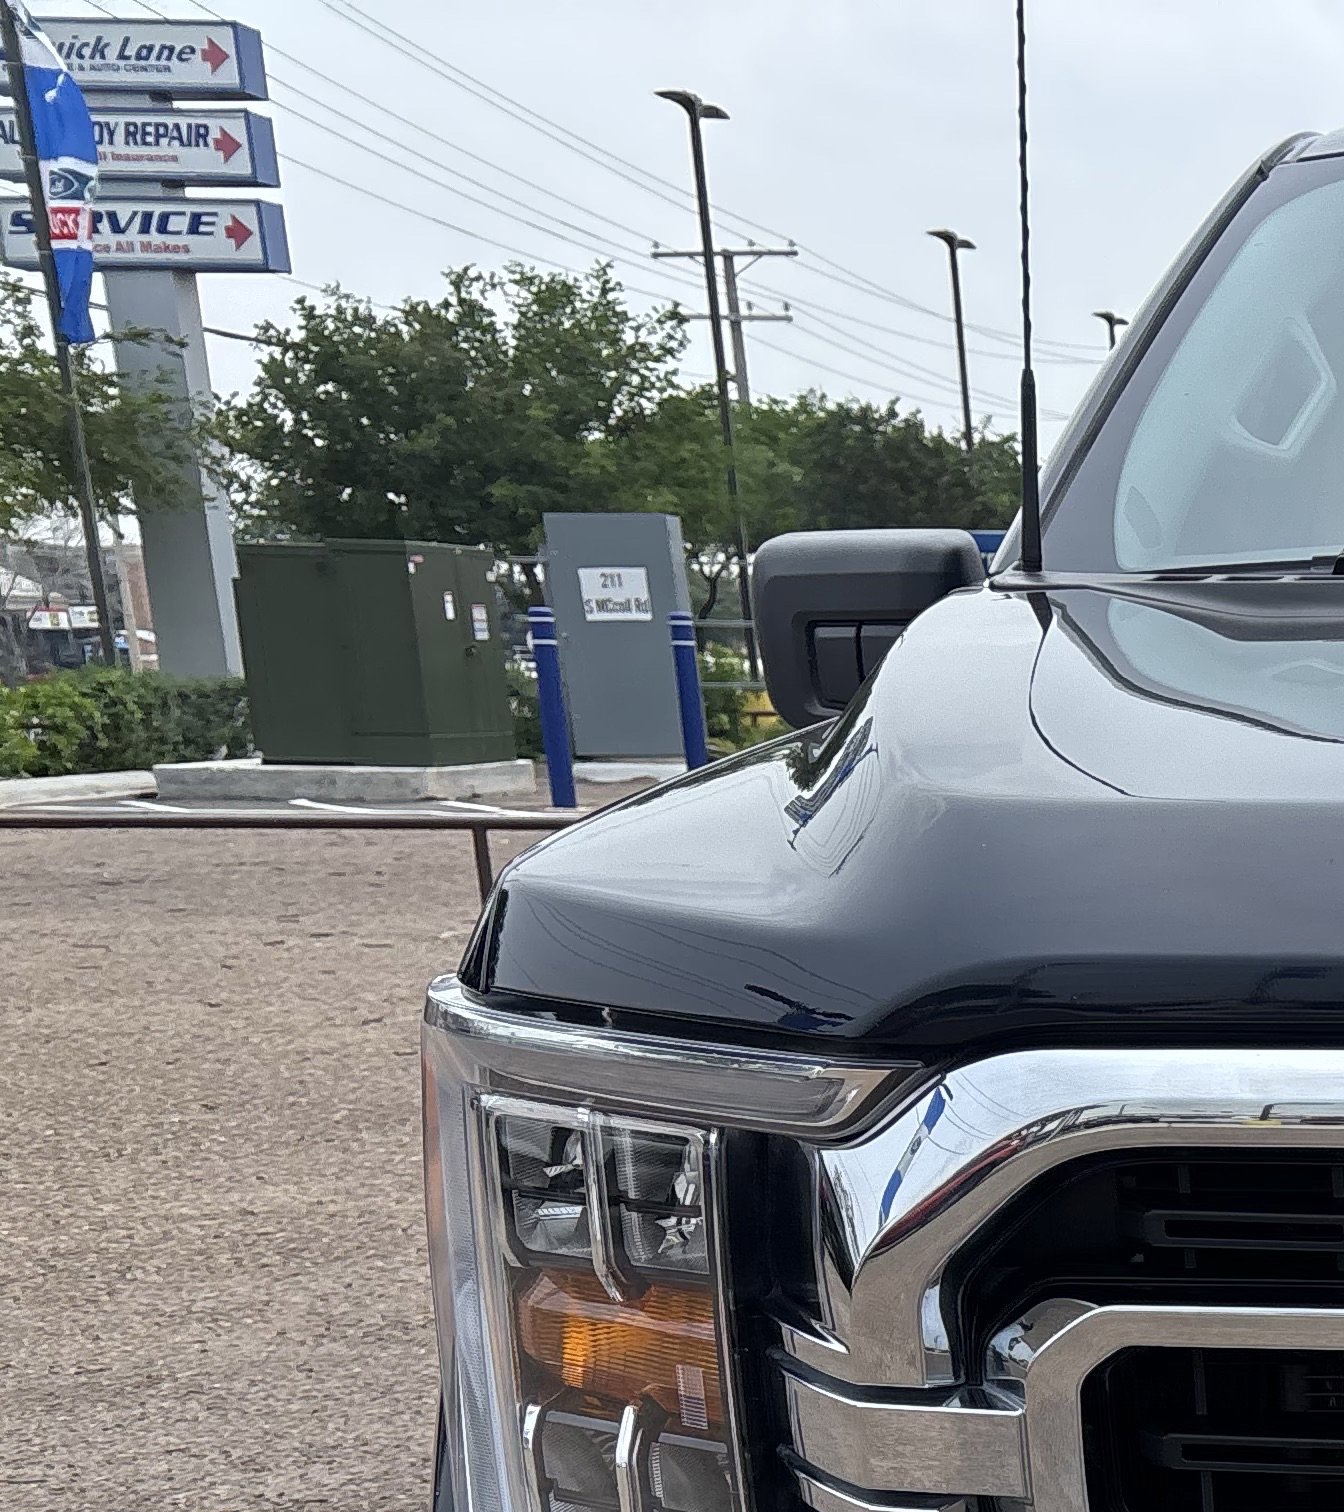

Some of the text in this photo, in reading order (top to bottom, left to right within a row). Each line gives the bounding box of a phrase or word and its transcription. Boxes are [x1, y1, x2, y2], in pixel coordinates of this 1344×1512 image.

[116, 35, 196, 62] Lane
[124, 121, 209, 147] REPAIR
[140, 241, 190, 253] Makes
